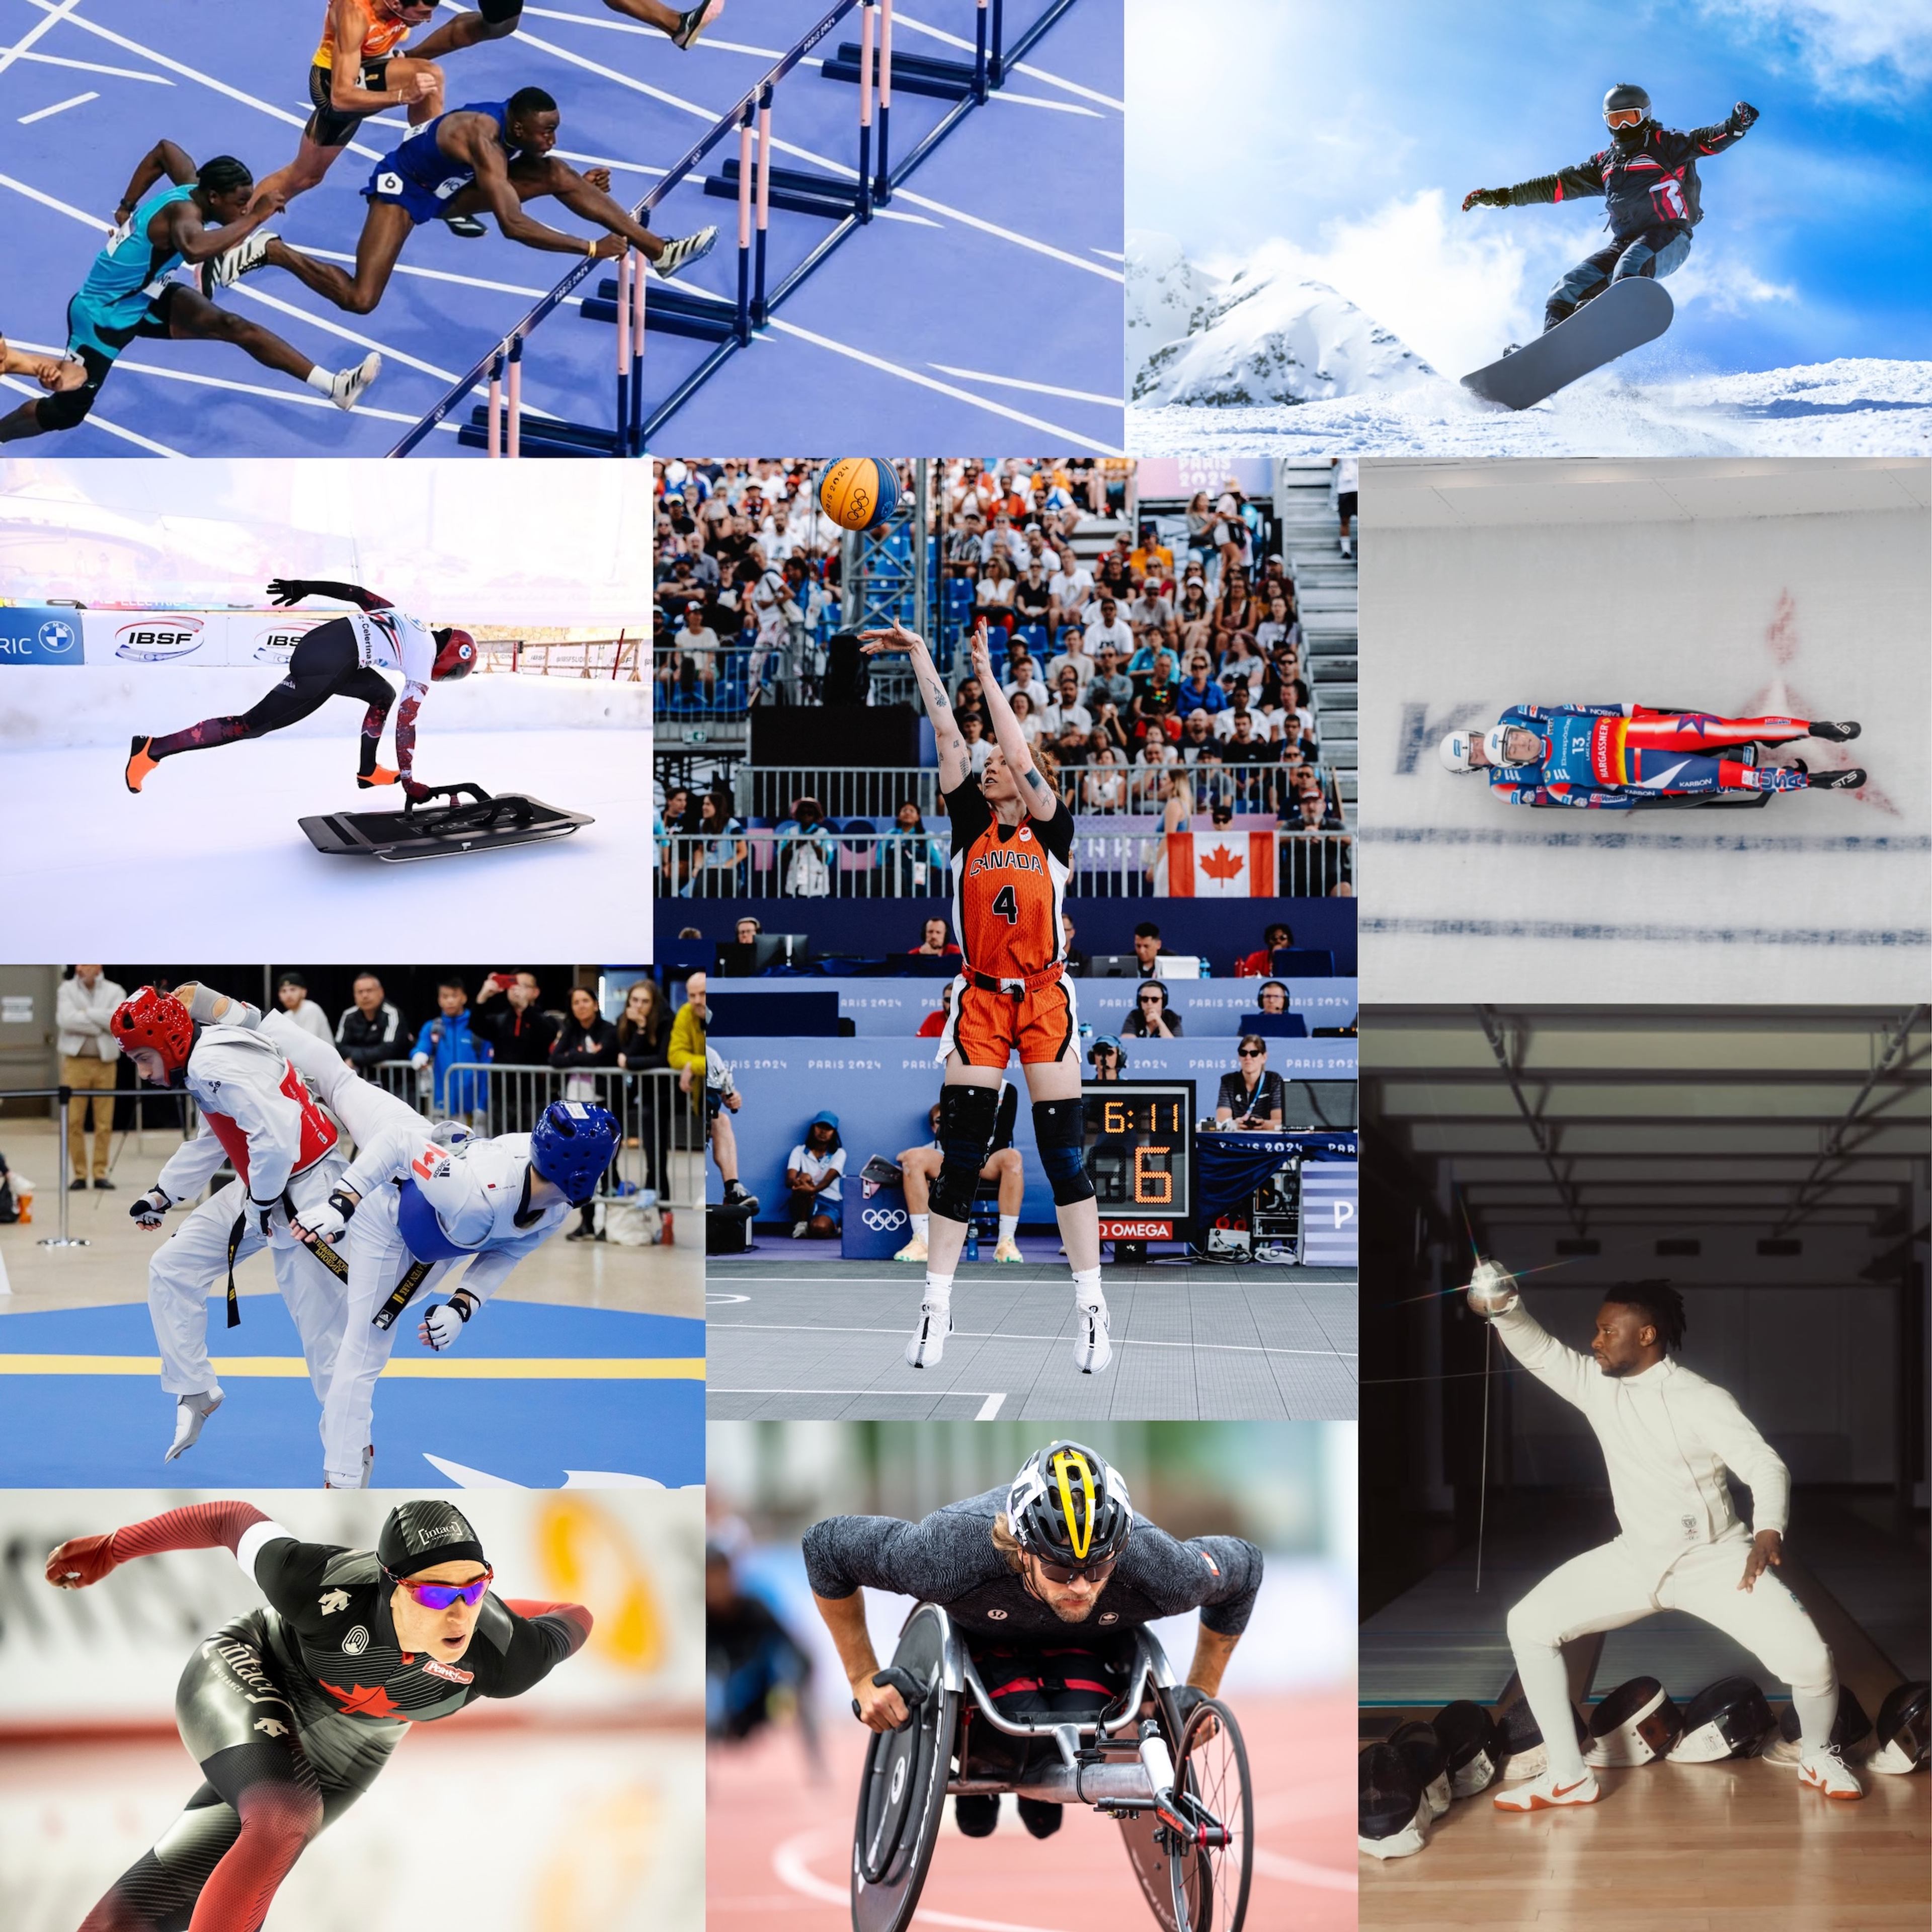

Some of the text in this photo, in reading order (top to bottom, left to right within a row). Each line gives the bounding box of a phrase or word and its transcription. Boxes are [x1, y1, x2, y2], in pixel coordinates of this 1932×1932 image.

[385, 176, 396, 189] 6
[830, 466, 849, 492] 2024
[43, 622, 69, 632] BMW
[129, 632, 193, 645] IBSF
[267, 635, 303, 647] IBS
[362, 623, 373, 659] Celerina
[1572, 737, 1585, 755] 13
[1597, 724, 1609, 778] HARGASSNER
[1679, 778, 1712, 787] KARBON
[970, 850, 1044, 877] CANADA
[992, 885, 1018, 925] 4
[841, 998, 902, 1007] ARIS 2024
[921, 998, 943, 1007] PAR
[1099, 999, 1133, 1007] PARIS
[1189, 999, 1224, 1007] PARIS
[1318, 998, 1349, 1006] 2024
[723, 1060, 787, 1069] ARIS 2024
[809, 1060, 881, 1069] PARIS 2024
[903, 1060, 939, 1069] PARIS
[1134, 1060, 1167, 1069] 2024
[1189, 1060, 1226, 1069] PARIS
[1286, 1059, 1324, 1068] PARIS
[1105, 1102, 1178, 1133] 6:11
[1265, 1142, 1303, 1152] 2024
[433, 1159, 449, 1179] adidas
[1135, 1147, 1172, 1203] 6
[1334, 1201, 1354, 1229] P
[1111, 1224, 1169, 1237] OMEGA
[399, 1280, 414, 1296] PARK
[209, 1661, 244, 1694] INSURANCE
[427, 1662, 460, 1680] Peavey
